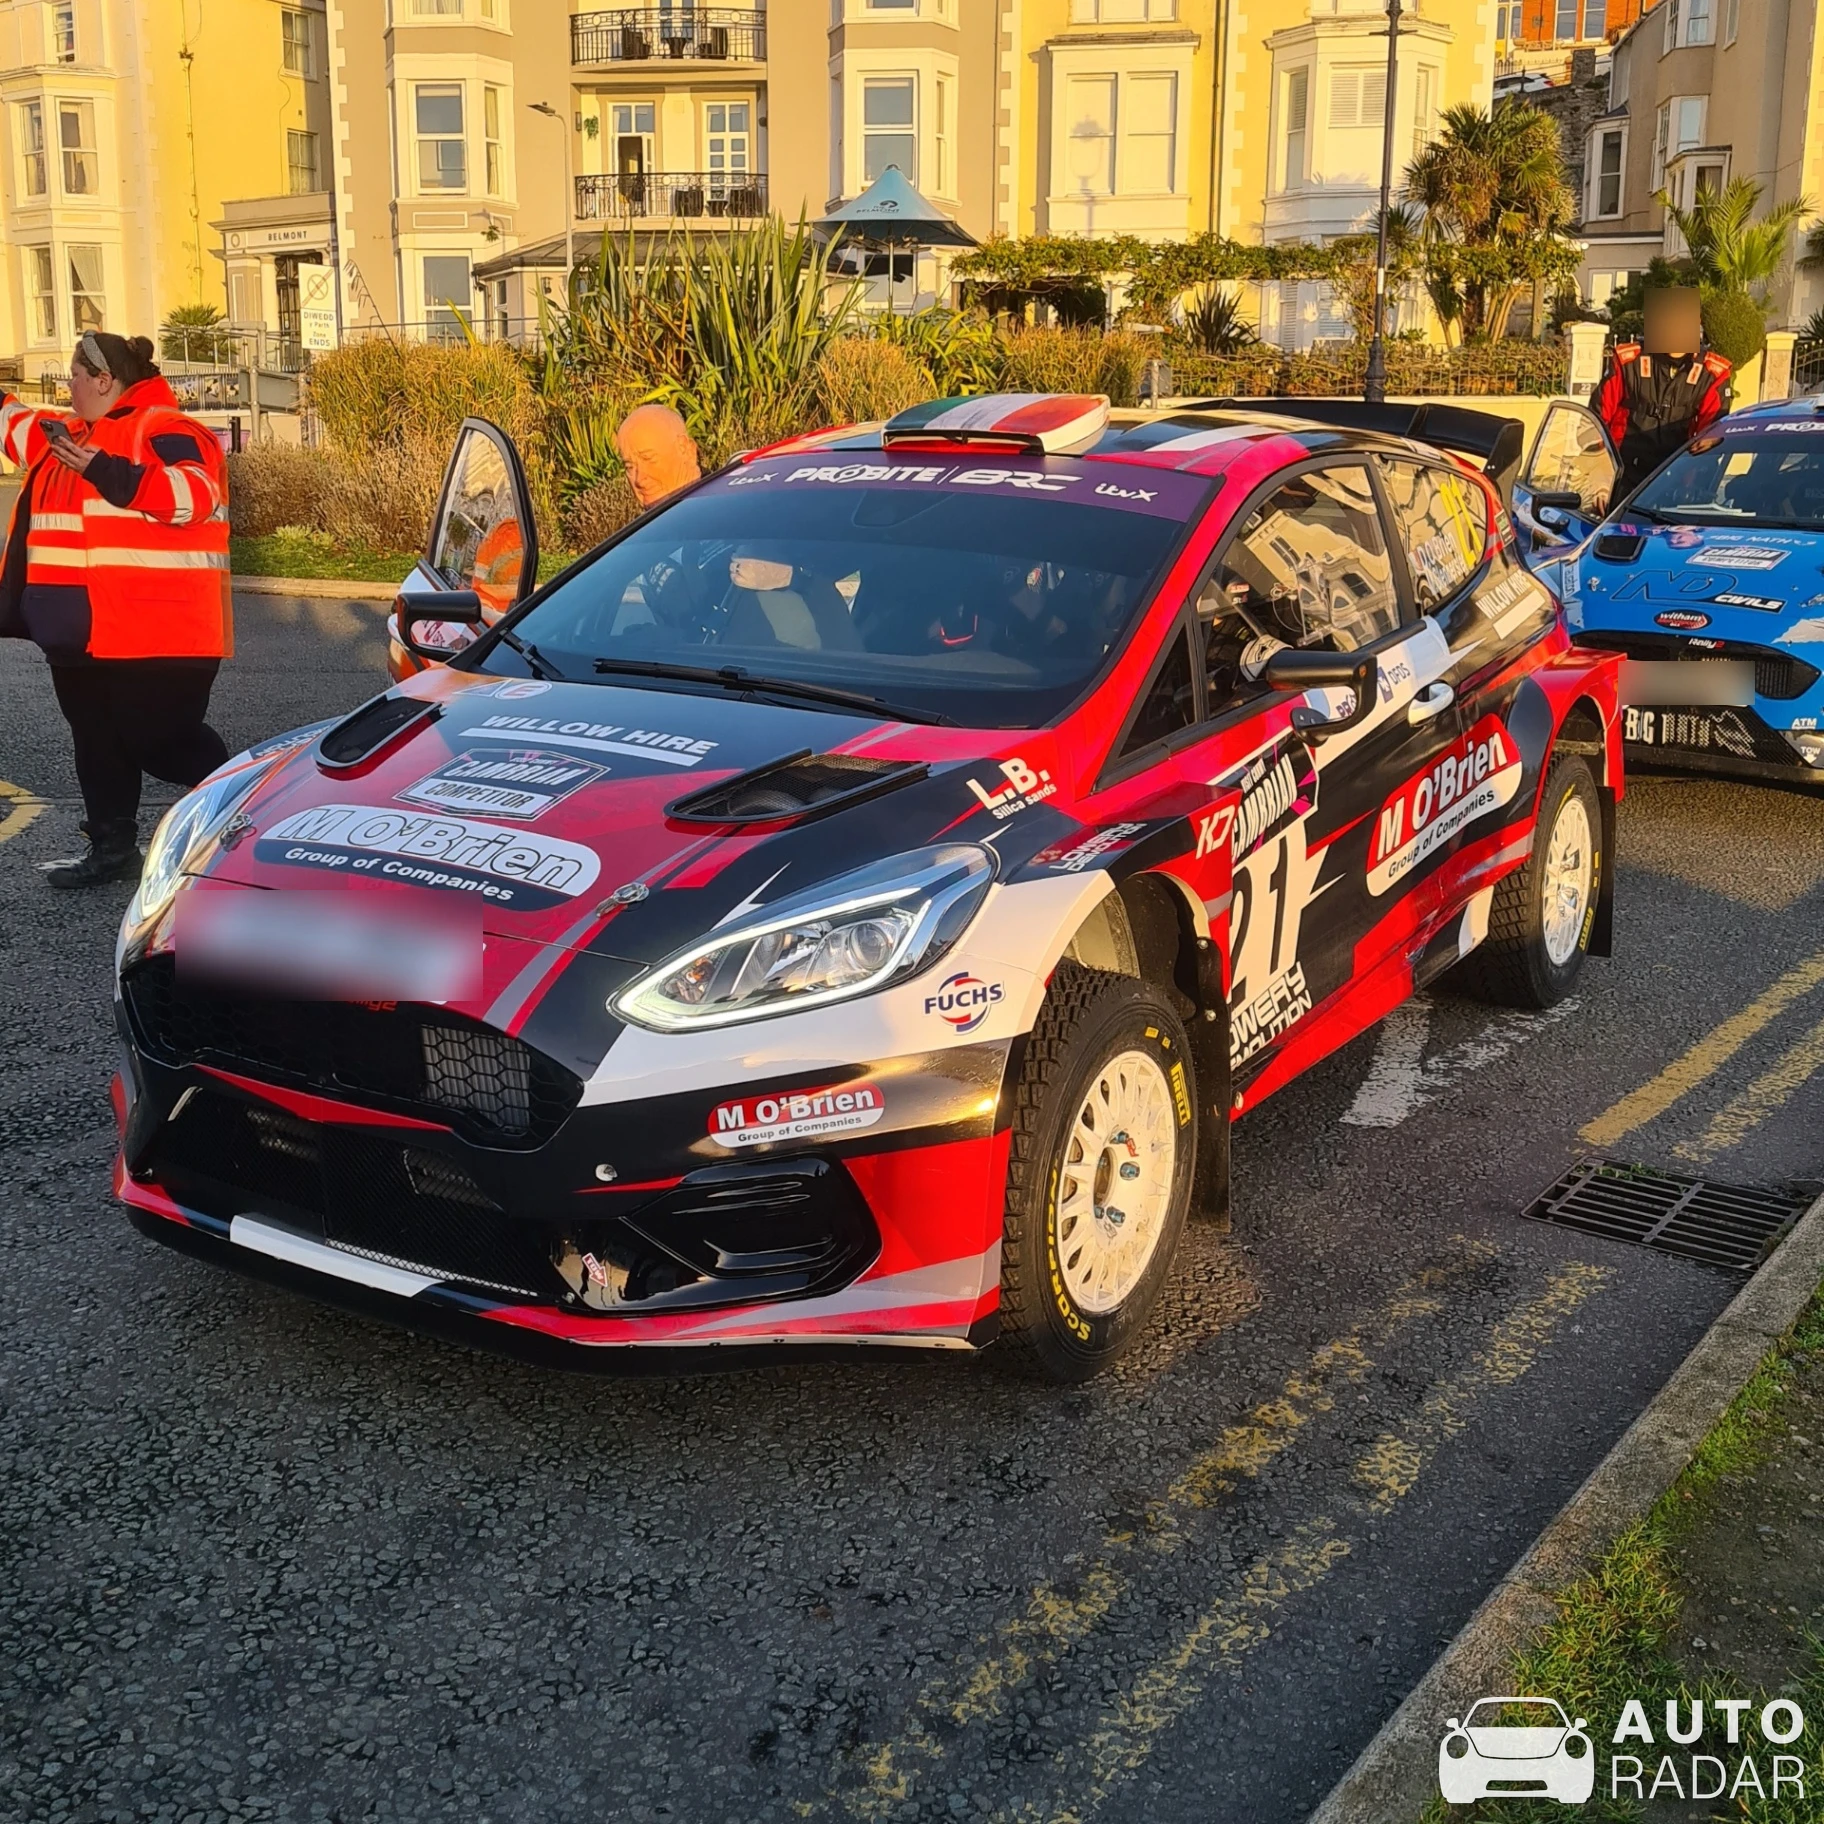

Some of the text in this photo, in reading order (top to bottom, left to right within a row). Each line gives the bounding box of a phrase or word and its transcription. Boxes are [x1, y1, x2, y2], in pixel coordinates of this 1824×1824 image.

[268, 231, 307, 241] BELMONT
[304, 311, 334, 321] DIWEDD
[309, 339, 330, 347] ENDS
[949, 468, 1083, 491] BRC
[1095, 483, 1158, 502] itvX
[1476, 579, 1517, 619] WILLOW
[1714, 594, 1783, 610] CIVILS
[1660, 612, 1702, 621] witham
[1688, 638, 1725, 649] Rally2
[1388, 662, 1411, 685] DFDS
[481, 715, 720, 754] WILLOW HIRE
[1791, 717, 1817, 730] ATM
[1800, 746, 1821, 755] TOW
[443, 760, 589, 786] CAMBRIAN
[424, 782, 534, 809] COMPETITOR
[1027, 782, 1058, 806] sands
[1376, 731, 1508, 863] M O'Brien
[1388, 789, 1495, 878] Group of Companies
[278, 808, 584, 890] M O'Brien
[284, 847, 515, 902] Group of Companies
[924, 983, 1003, 1014] FUCHS
[1230, 961, 1306, 1051] WERY
[1170, 1061, 1192, 1129] PIRELLI
[717, 1088, 875, 1131] M O'Brien
[738, 1115, 862, 1143] Group of Companies
